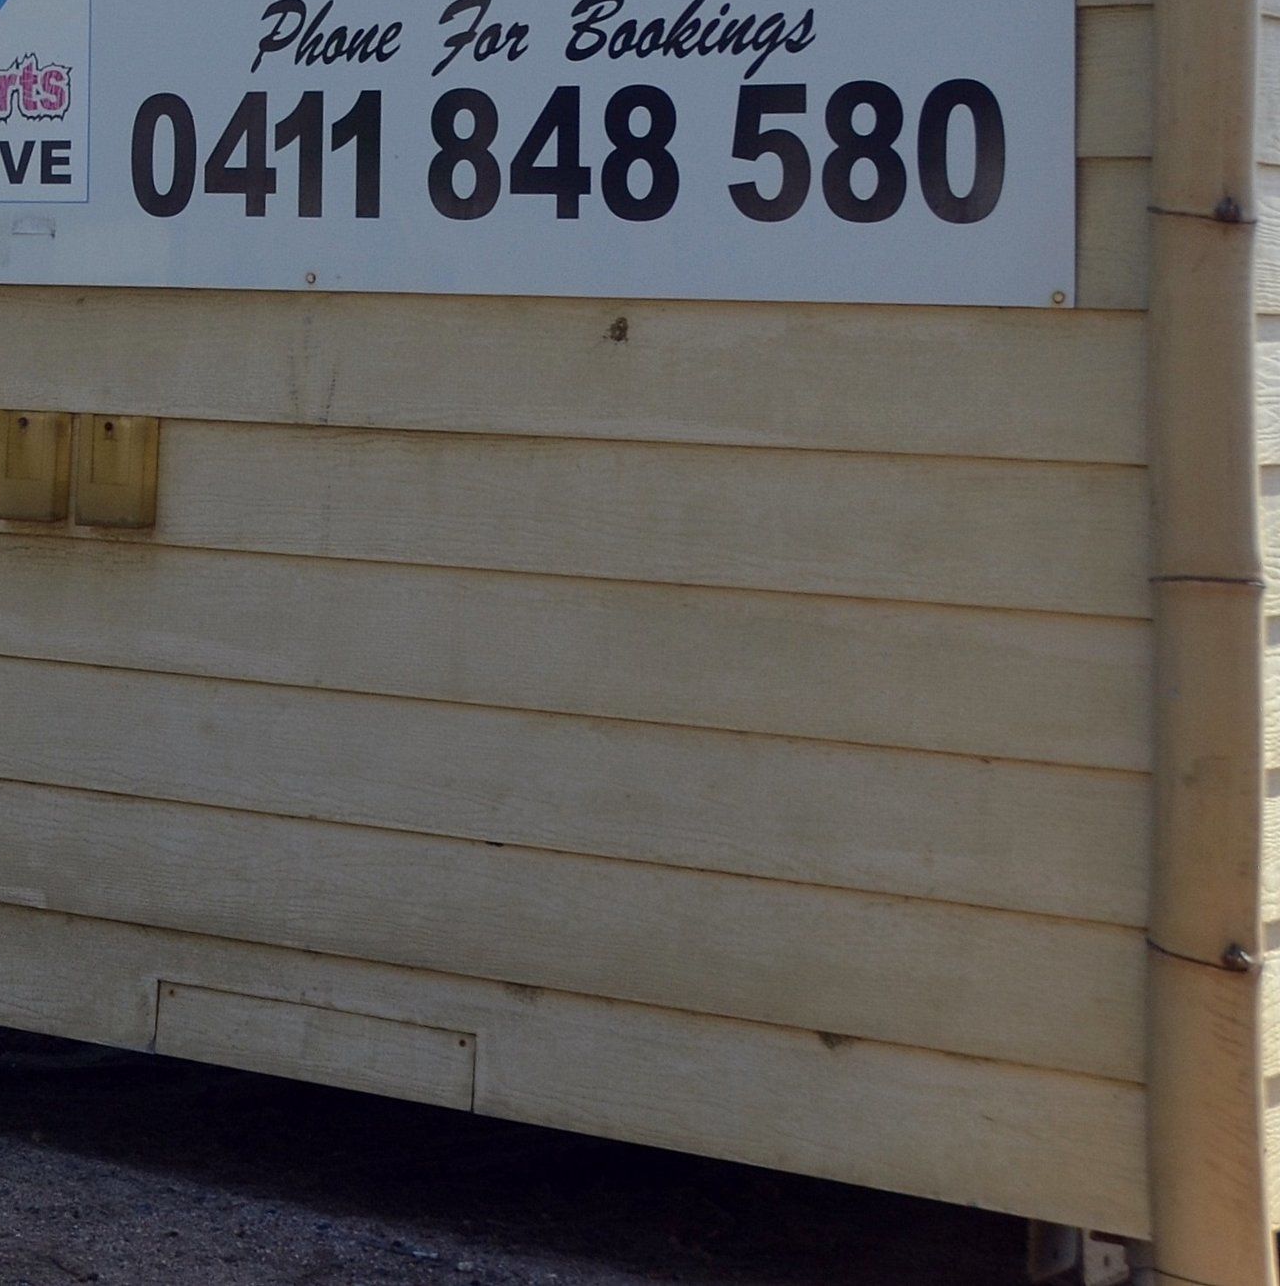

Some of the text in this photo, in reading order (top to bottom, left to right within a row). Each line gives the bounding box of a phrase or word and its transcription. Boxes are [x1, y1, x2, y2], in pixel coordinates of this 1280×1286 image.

[130, 78, 1007, 224] 0411 848 580
